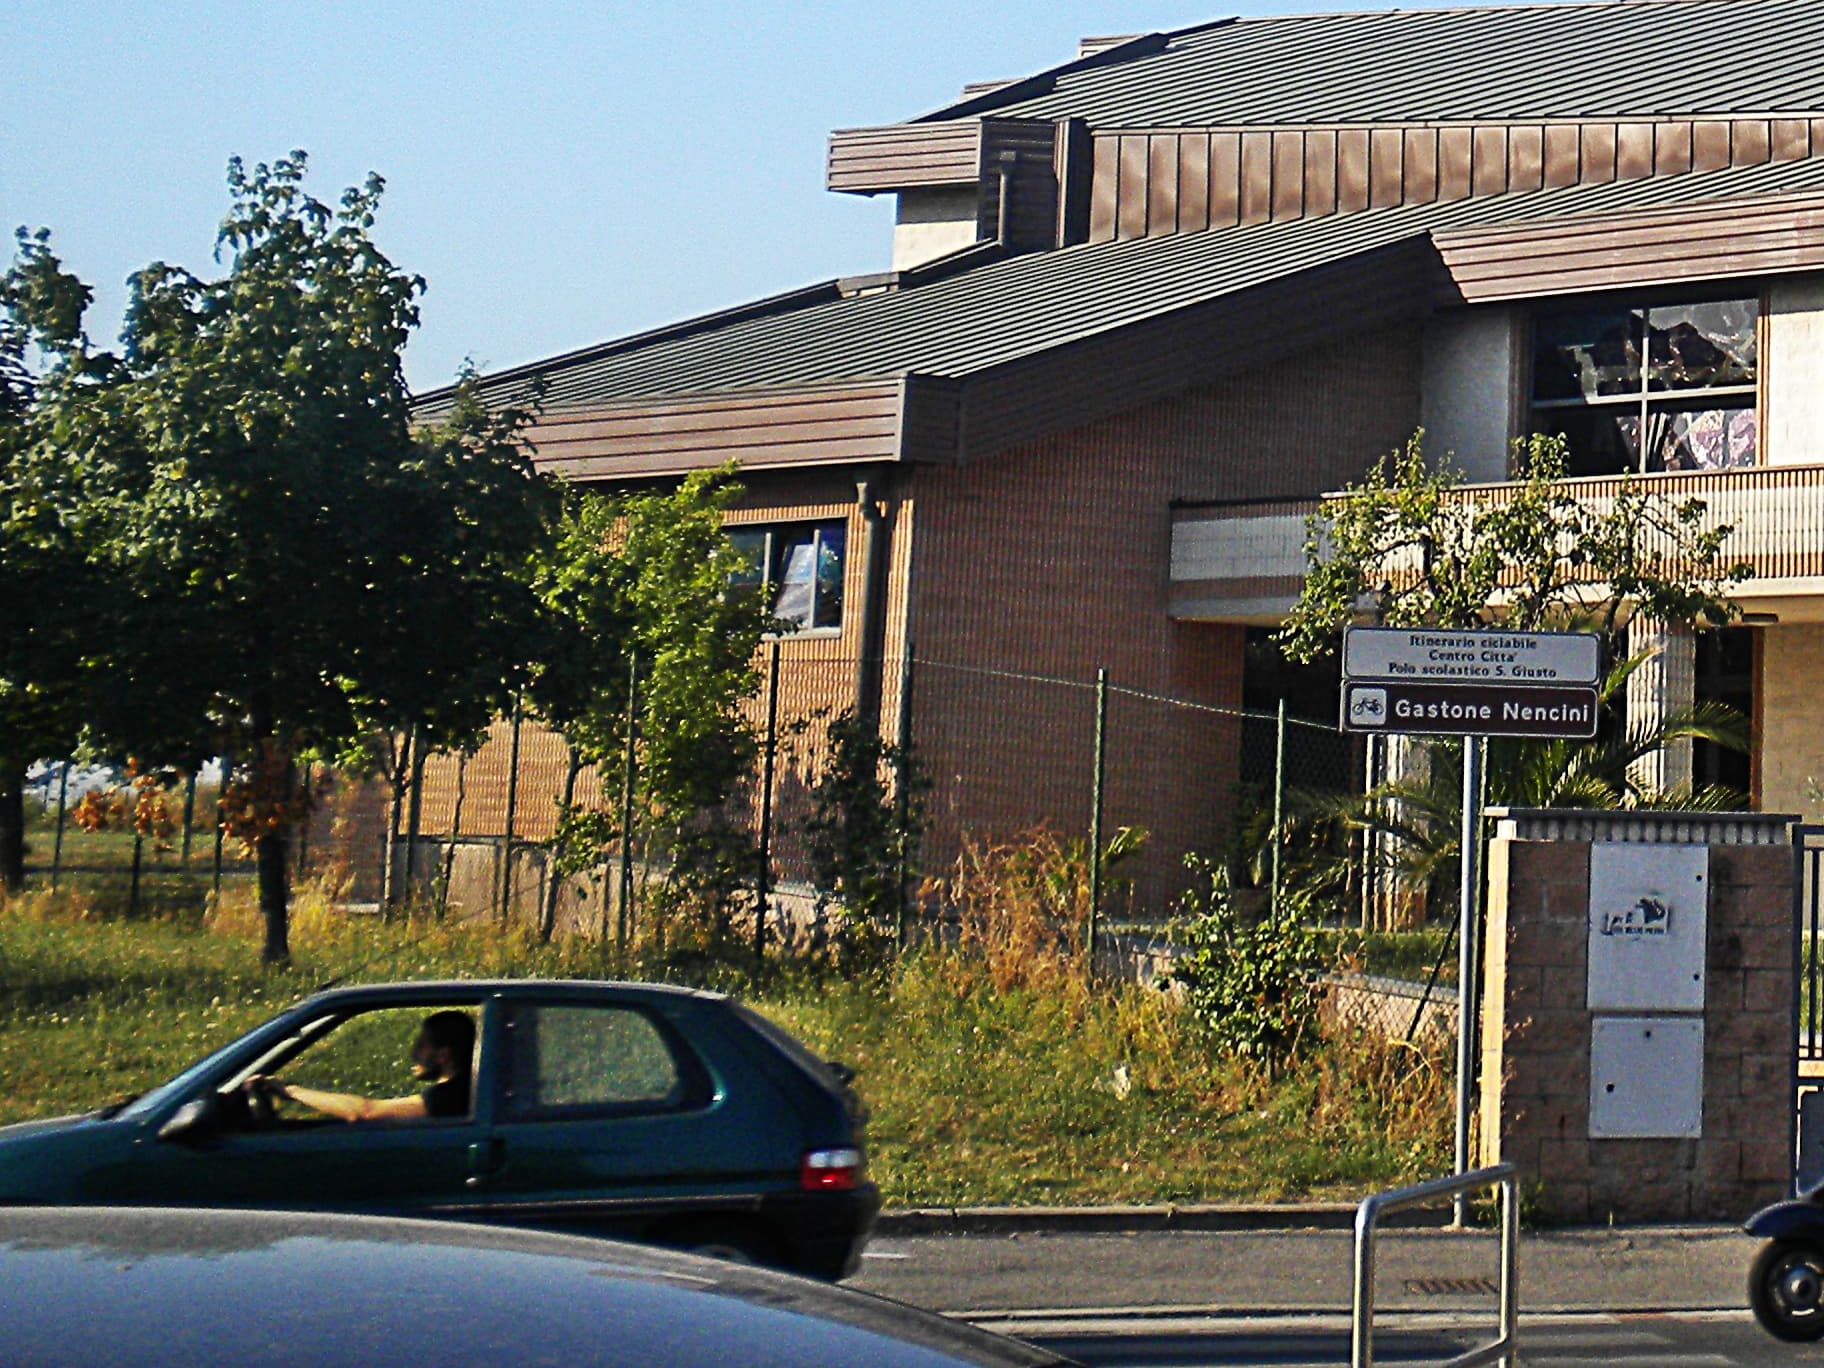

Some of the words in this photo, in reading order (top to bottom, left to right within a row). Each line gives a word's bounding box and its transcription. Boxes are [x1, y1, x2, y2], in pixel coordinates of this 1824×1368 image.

[1410, 635, 1475, 648] Itinerario
[1481, 636, 1537, 649] ciclabile
[1429, 649, 1475, 662] Centro
[1388, 662, 1417, 675] Polo
[1422, 664, 1489, 677] scolastico
[1495, 665, 1507, 677] S.
[1511, 666, 1557, 679] Giusto
[1395, 699, 1492, 720] Gastone
[1502, 702, 1589, 723] Nencini
